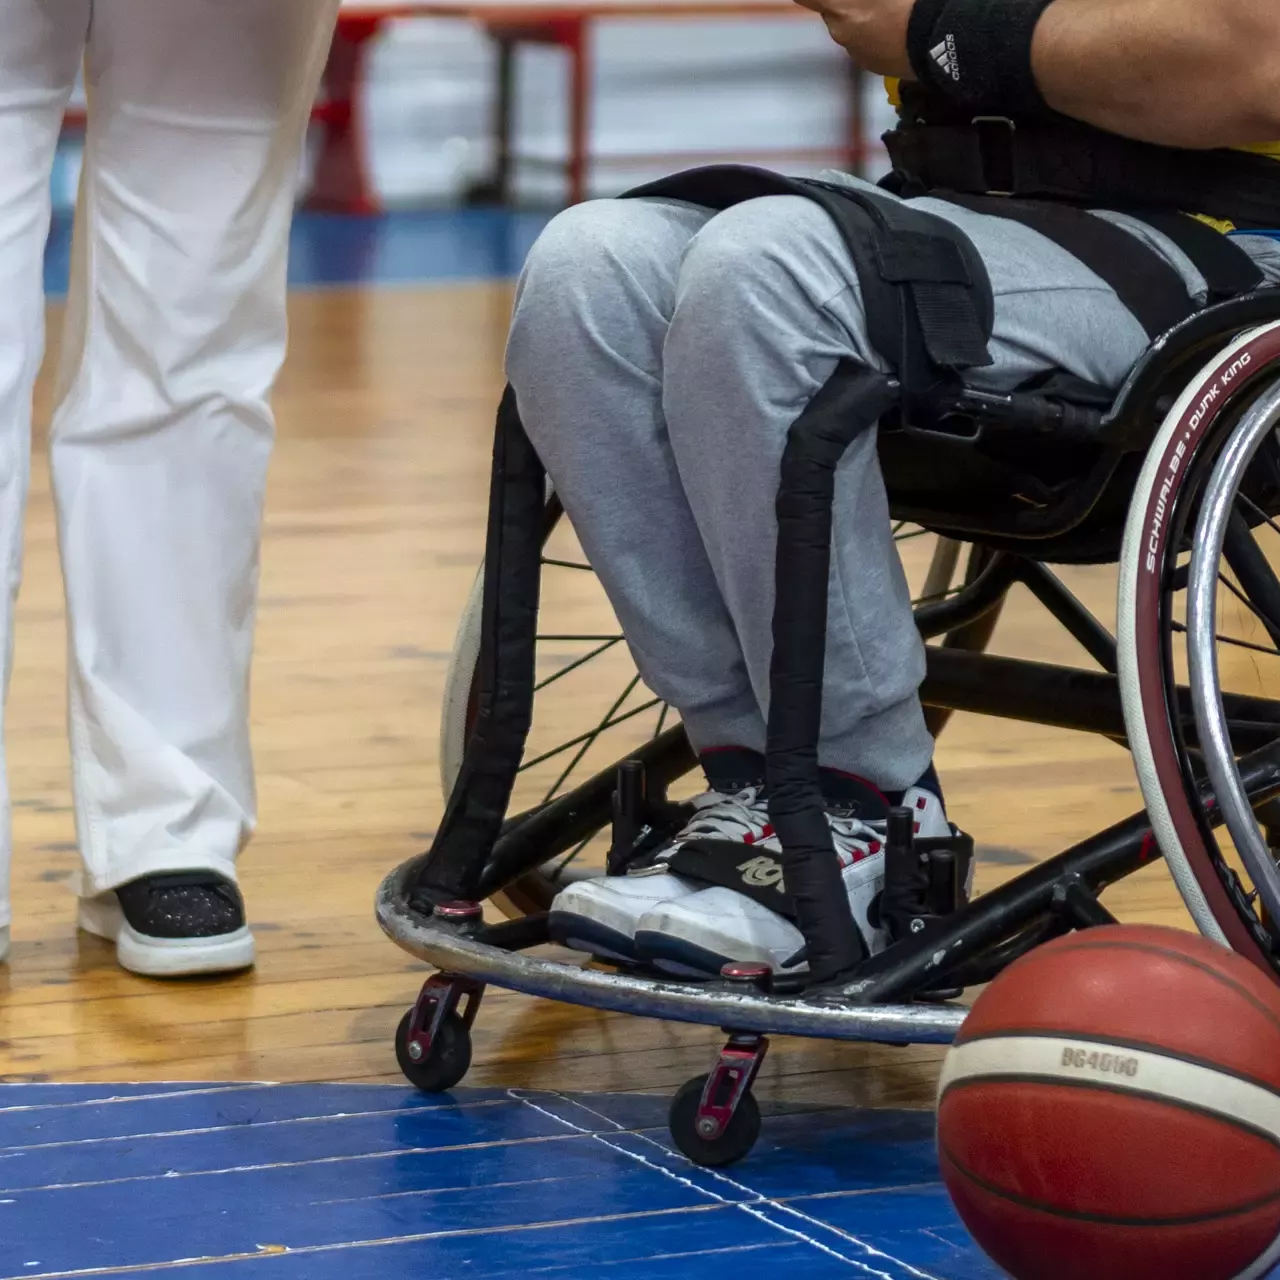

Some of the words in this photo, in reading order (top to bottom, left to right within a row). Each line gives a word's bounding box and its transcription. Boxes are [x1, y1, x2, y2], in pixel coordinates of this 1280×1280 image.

[945, 33, 960, 81] adidas
[1146, 440, 1186, 573] SCHWALBE
[1189, 384, 1220, 431] DUNK
[1221, 352, 1252, 386] KING
